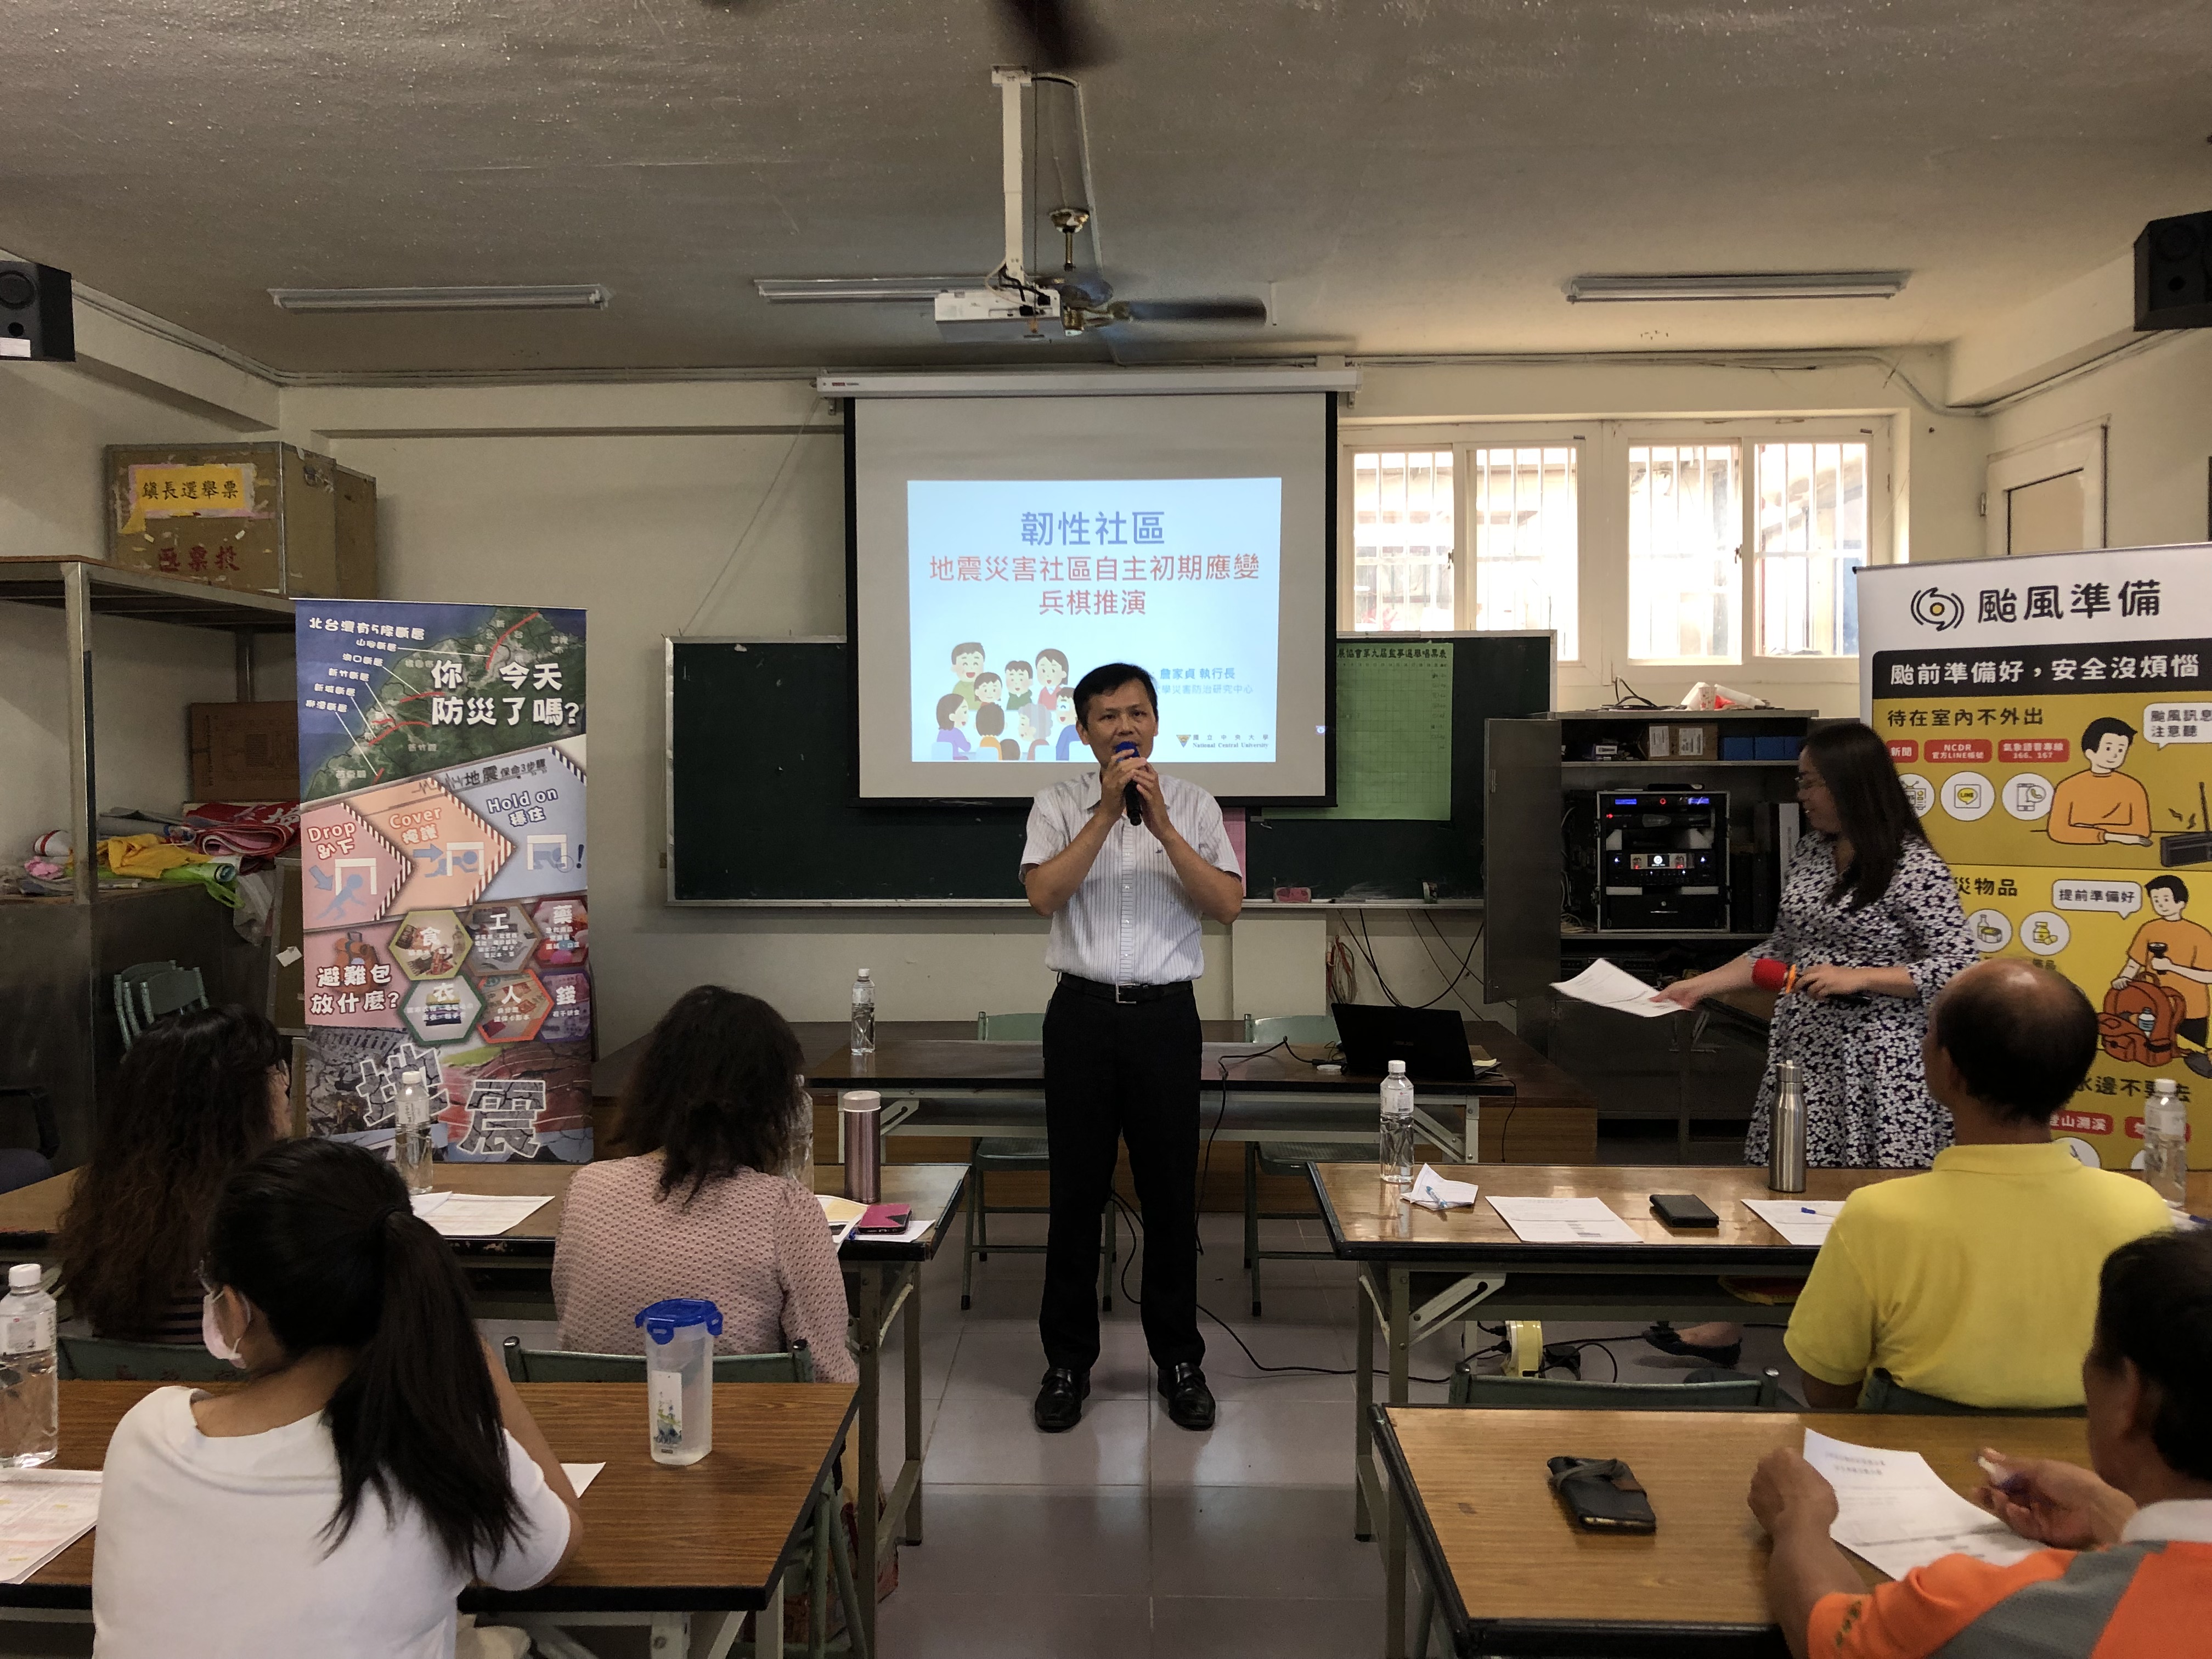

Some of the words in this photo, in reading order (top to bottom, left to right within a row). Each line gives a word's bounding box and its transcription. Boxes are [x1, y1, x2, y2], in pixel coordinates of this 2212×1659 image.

[1021, 511, 1165, 545] 韌性社區
[929, 554, 1259, 583] 地震災害社區自主初期應變
[1039, 590, 1146, 616] 兵棋推演
[1978, 580, 2160, 624] 颱風準備
[431, 659, 464, 689] 你
[499, 662, 563, 691] 今天
[1200, 668, 1235, 679] 執行長
[1891, 654, 2199, 686] 颱前準備好，安全沒煩惱
[432, 697, 579, 726] 防災了嗎?
[1888, 708, 2044, 727] 待在室內不外出
[487, 791, 532, 814] Hold
[535, 788, 558, 803] on
[390, 808, 442, 830] Cover
[307, 822, 356, 843] Drop
[488, 913, 510, 930] 工
[419, 926, 442, 952] 食
[316, 963, 392, 988] 避難包
[309, 990, 400, 1015] 放什麼?
[433, 983, 455, 1002] 衣
[501, 985, 521, 1005] 人
